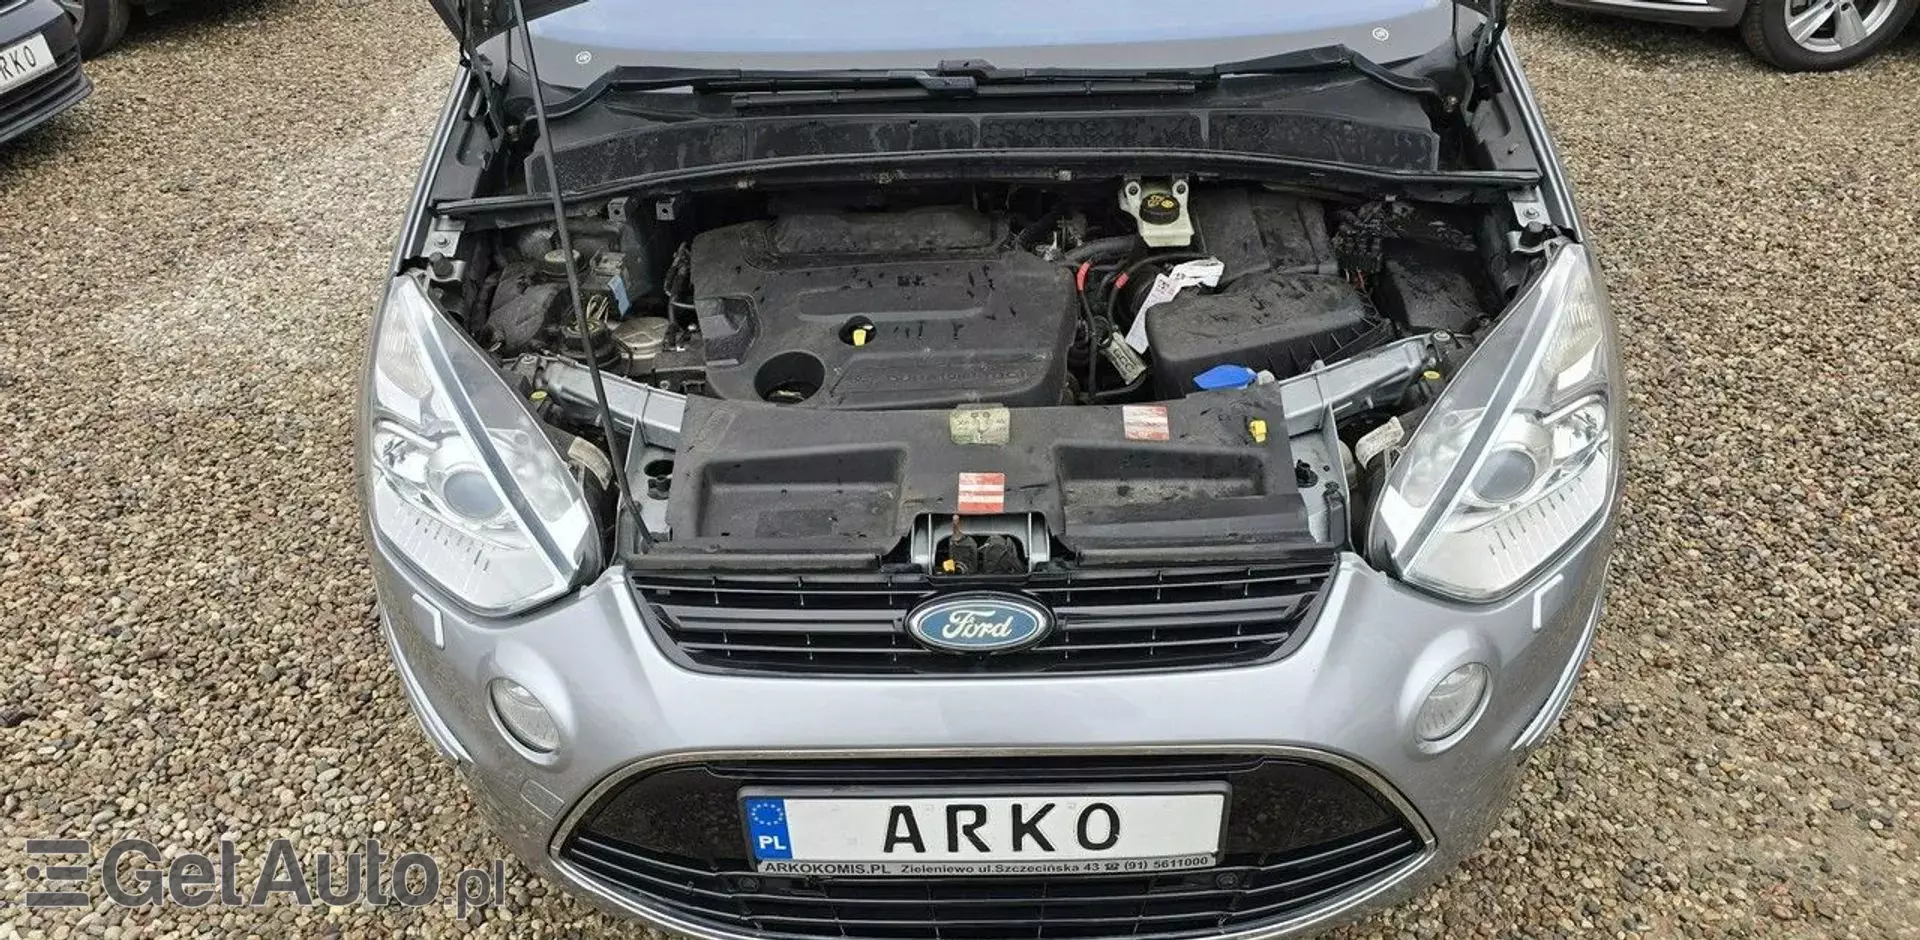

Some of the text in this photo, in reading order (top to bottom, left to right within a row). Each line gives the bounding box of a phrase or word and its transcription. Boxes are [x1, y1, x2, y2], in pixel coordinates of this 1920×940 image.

[942, 610, 1013, 638] Ford
[884, 802, 1121, 853] ARKO
[758, 835, 787, 850] PL
[765, 862, 891, 875] ARKOKOMIS.PL
[901, 865, 974, 874] Zieleniewo
[1084, 863, 1100, 872] 43
[1124, 860, 1148, 871] (91)
[1153, 856, 1208, 868] 5611000
